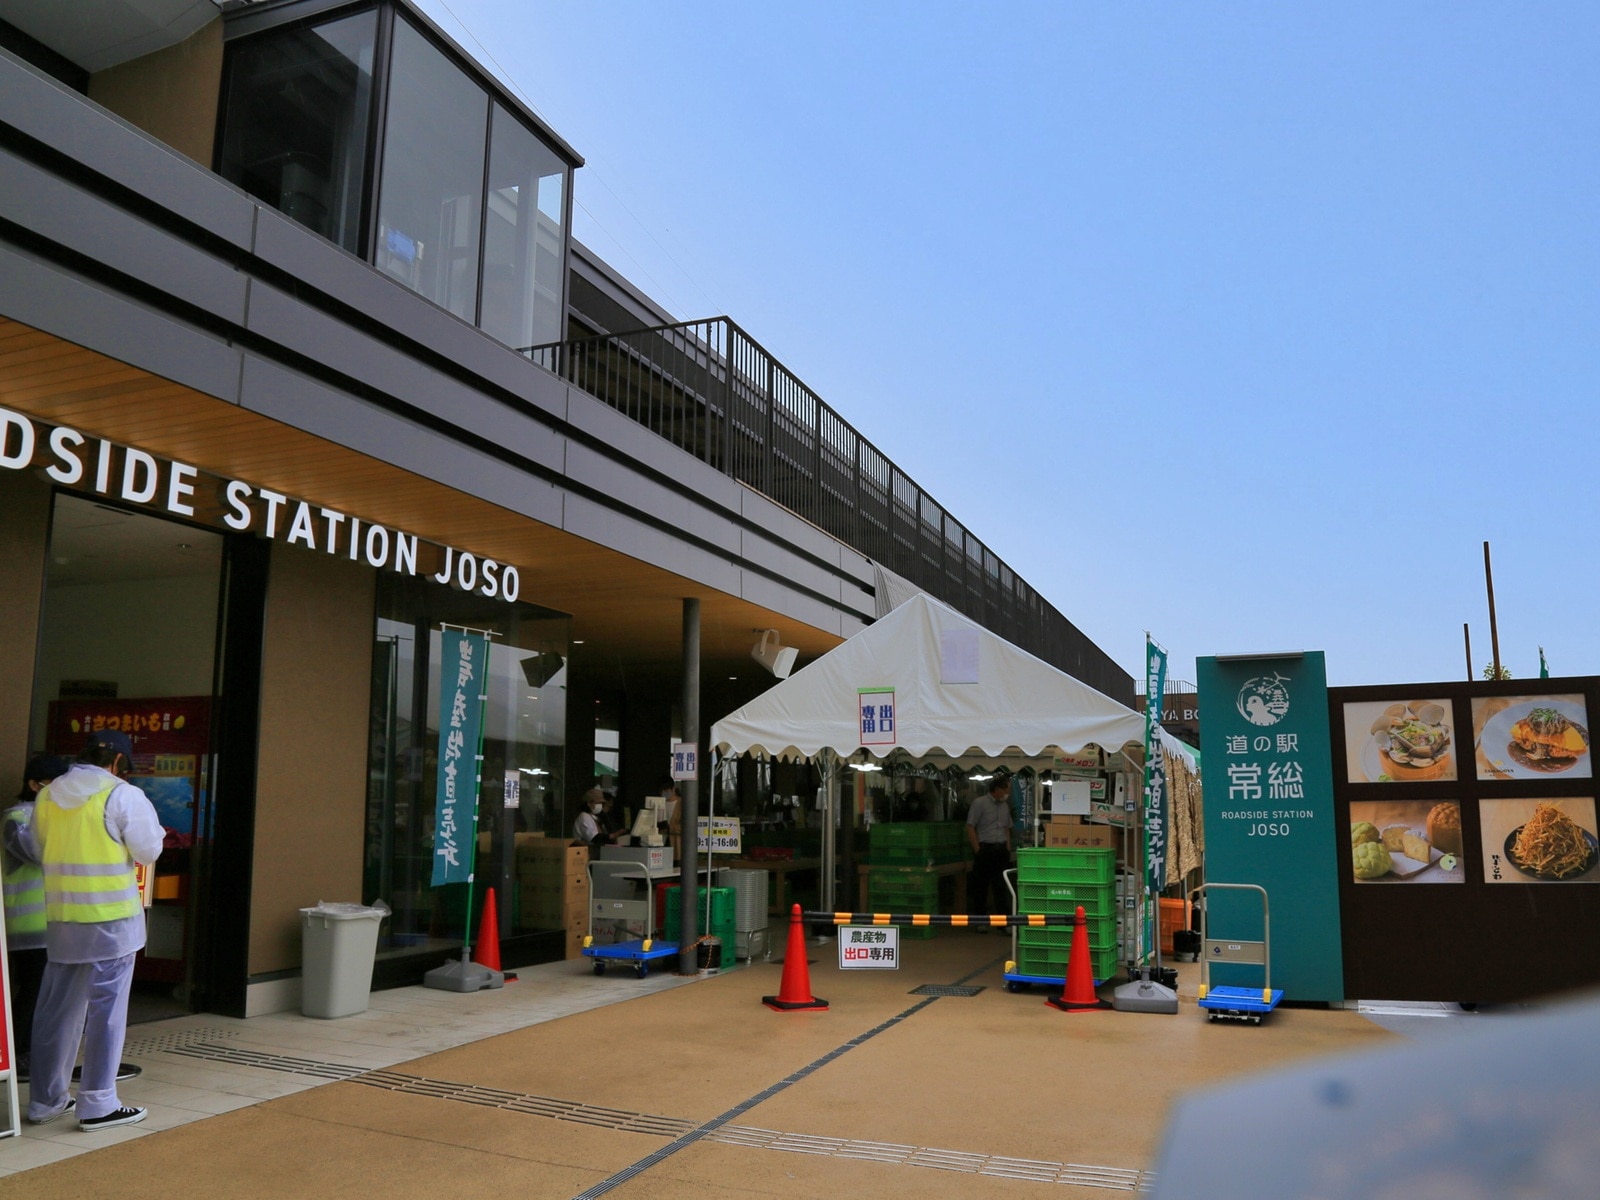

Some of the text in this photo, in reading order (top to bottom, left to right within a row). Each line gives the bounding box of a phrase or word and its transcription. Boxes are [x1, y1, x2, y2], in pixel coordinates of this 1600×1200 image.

[223, 480, 418, 576] STATION
[434, 546, 520, 603] JOSO
[92, 713, 161, 732] さつまいも
[862, 704, 876, 733] 専用
[879, 704, 893, 732] 出口
[1225, 733, 1299, 754] 道の駅
[686, 752, 695, 772] 出口
[1227, 761, 1305, 799] 常総
[1221, 810, 1314, 820] ROADSIDE STATION
[1247, 823, 1290, 836] JOSO
[850, 930, 887, 943] 農産物
[844, 947, 895, 960] 出口専用
